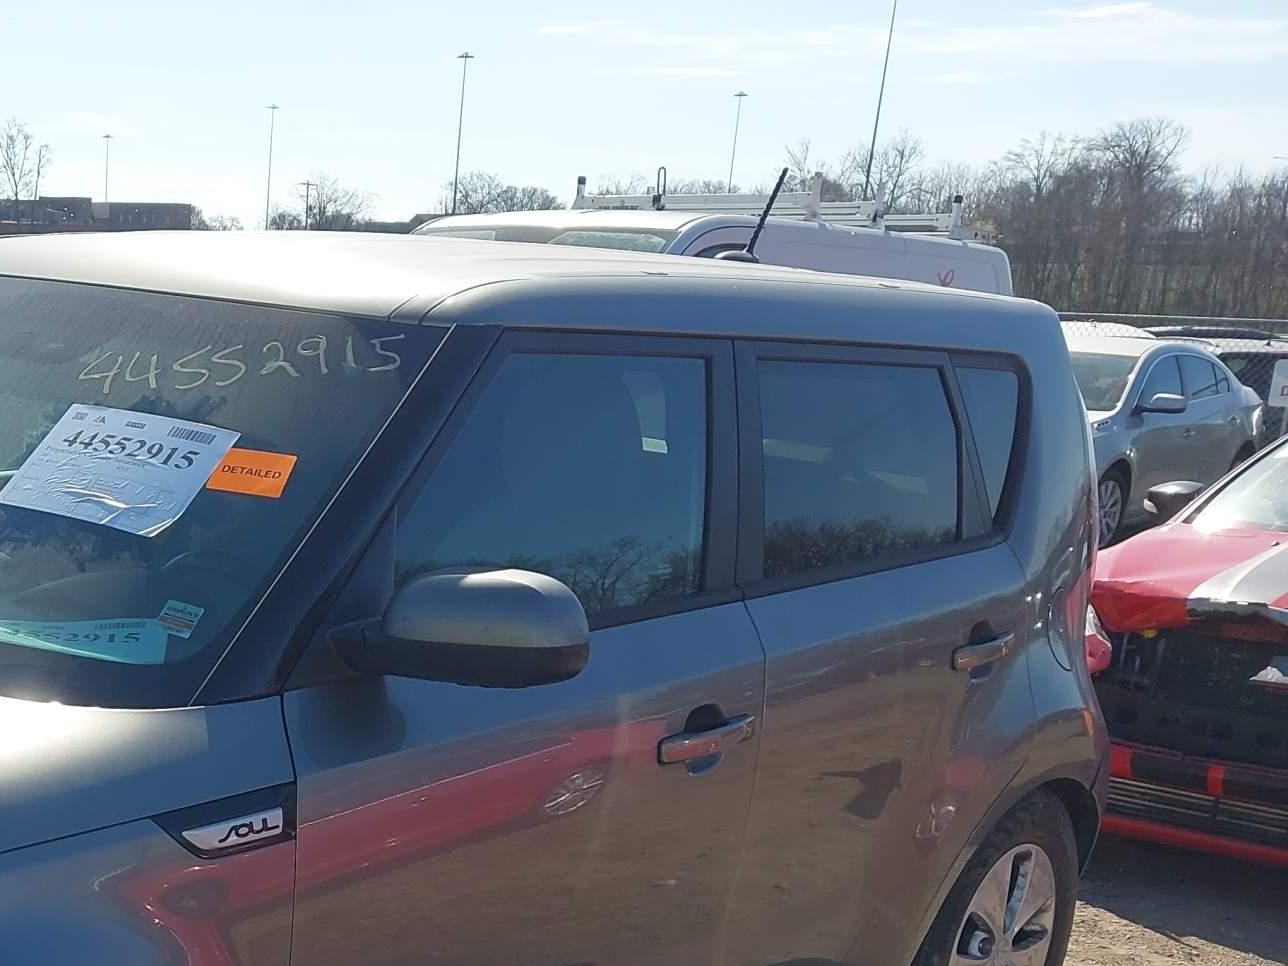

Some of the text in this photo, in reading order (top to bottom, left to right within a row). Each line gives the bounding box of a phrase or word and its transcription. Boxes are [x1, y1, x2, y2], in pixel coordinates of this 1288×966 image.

[78, 334, 406, 394] 44552915
[63, 429, 200, 470] 44552915
[221, 464, 282, 479] DETAILED
[218, 818, 280, 843] SOUL
